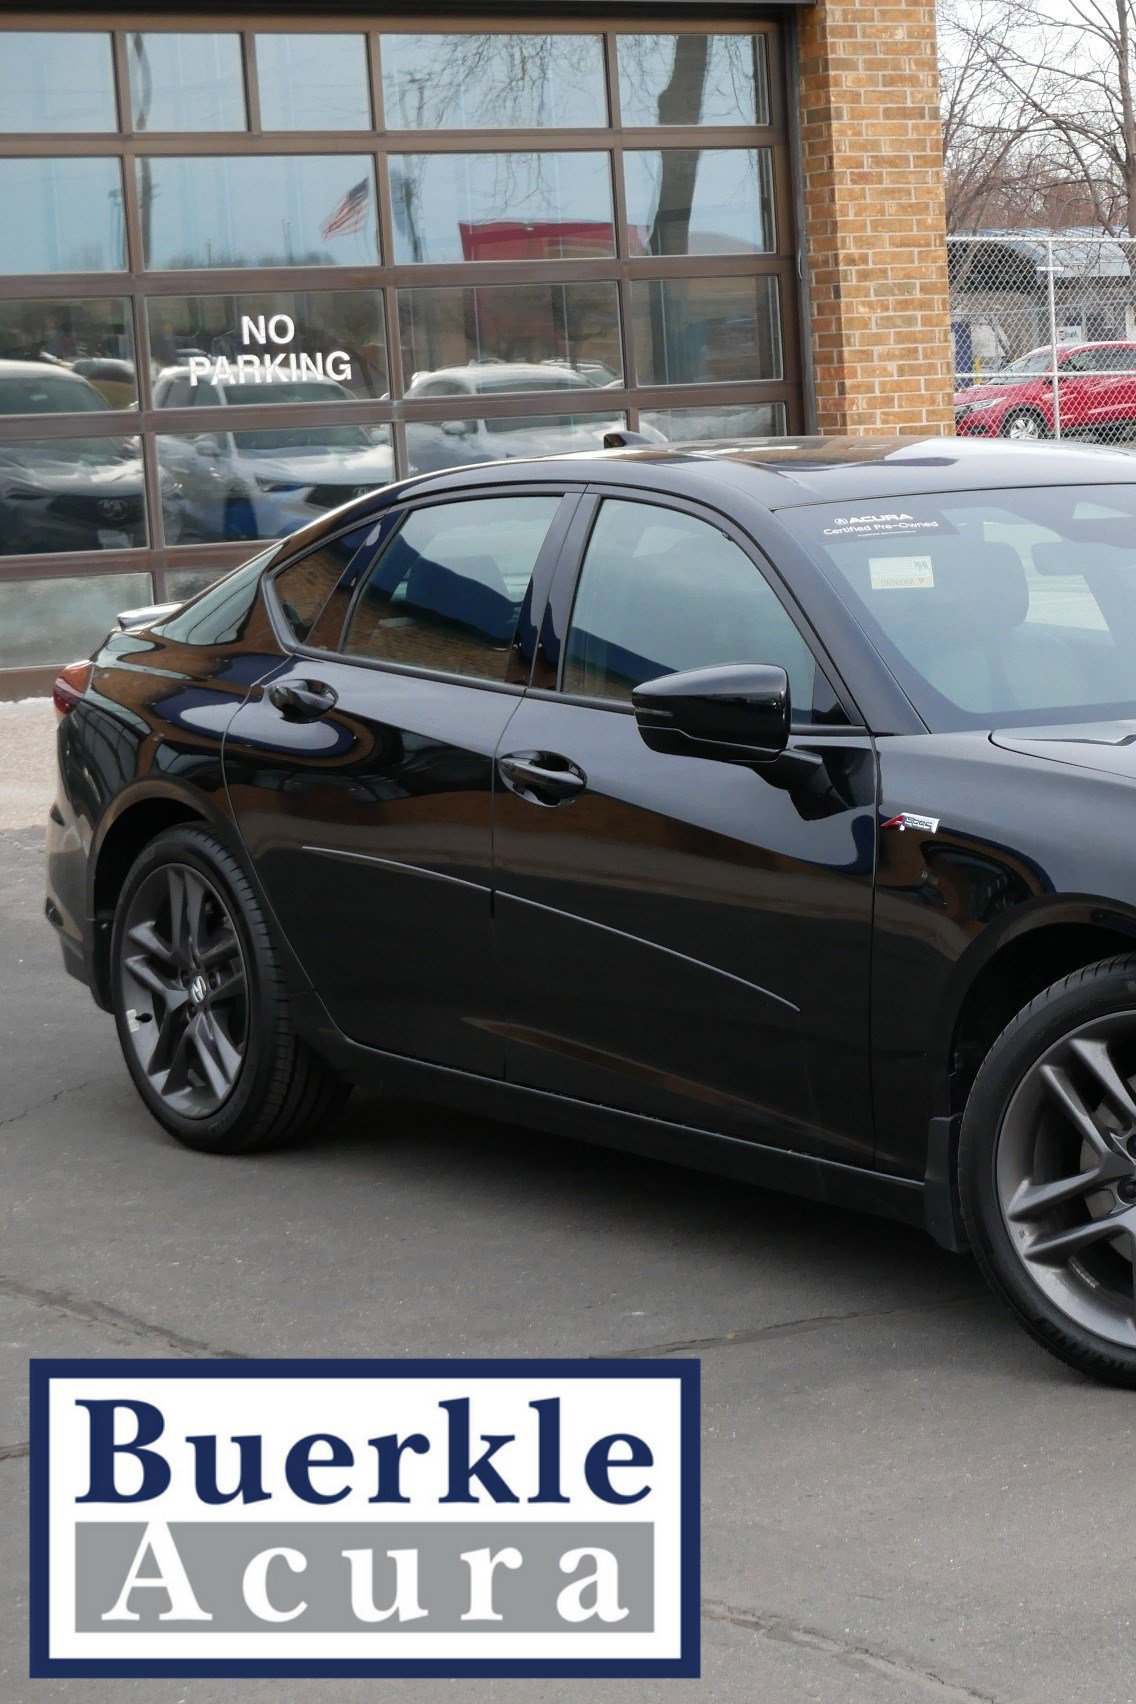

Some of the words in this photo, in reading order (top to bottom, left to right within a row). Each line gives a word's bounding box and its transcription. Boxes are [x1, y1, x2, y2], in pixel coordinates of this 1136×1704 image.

[241, 314, 295, 345] NO
[189, 351, 352, 386] PARKING
[823, 525, 872, 535] Certified
[874, 521, 939, 530] Pre-Owned
[849, 513, 914, 524] ACURA
